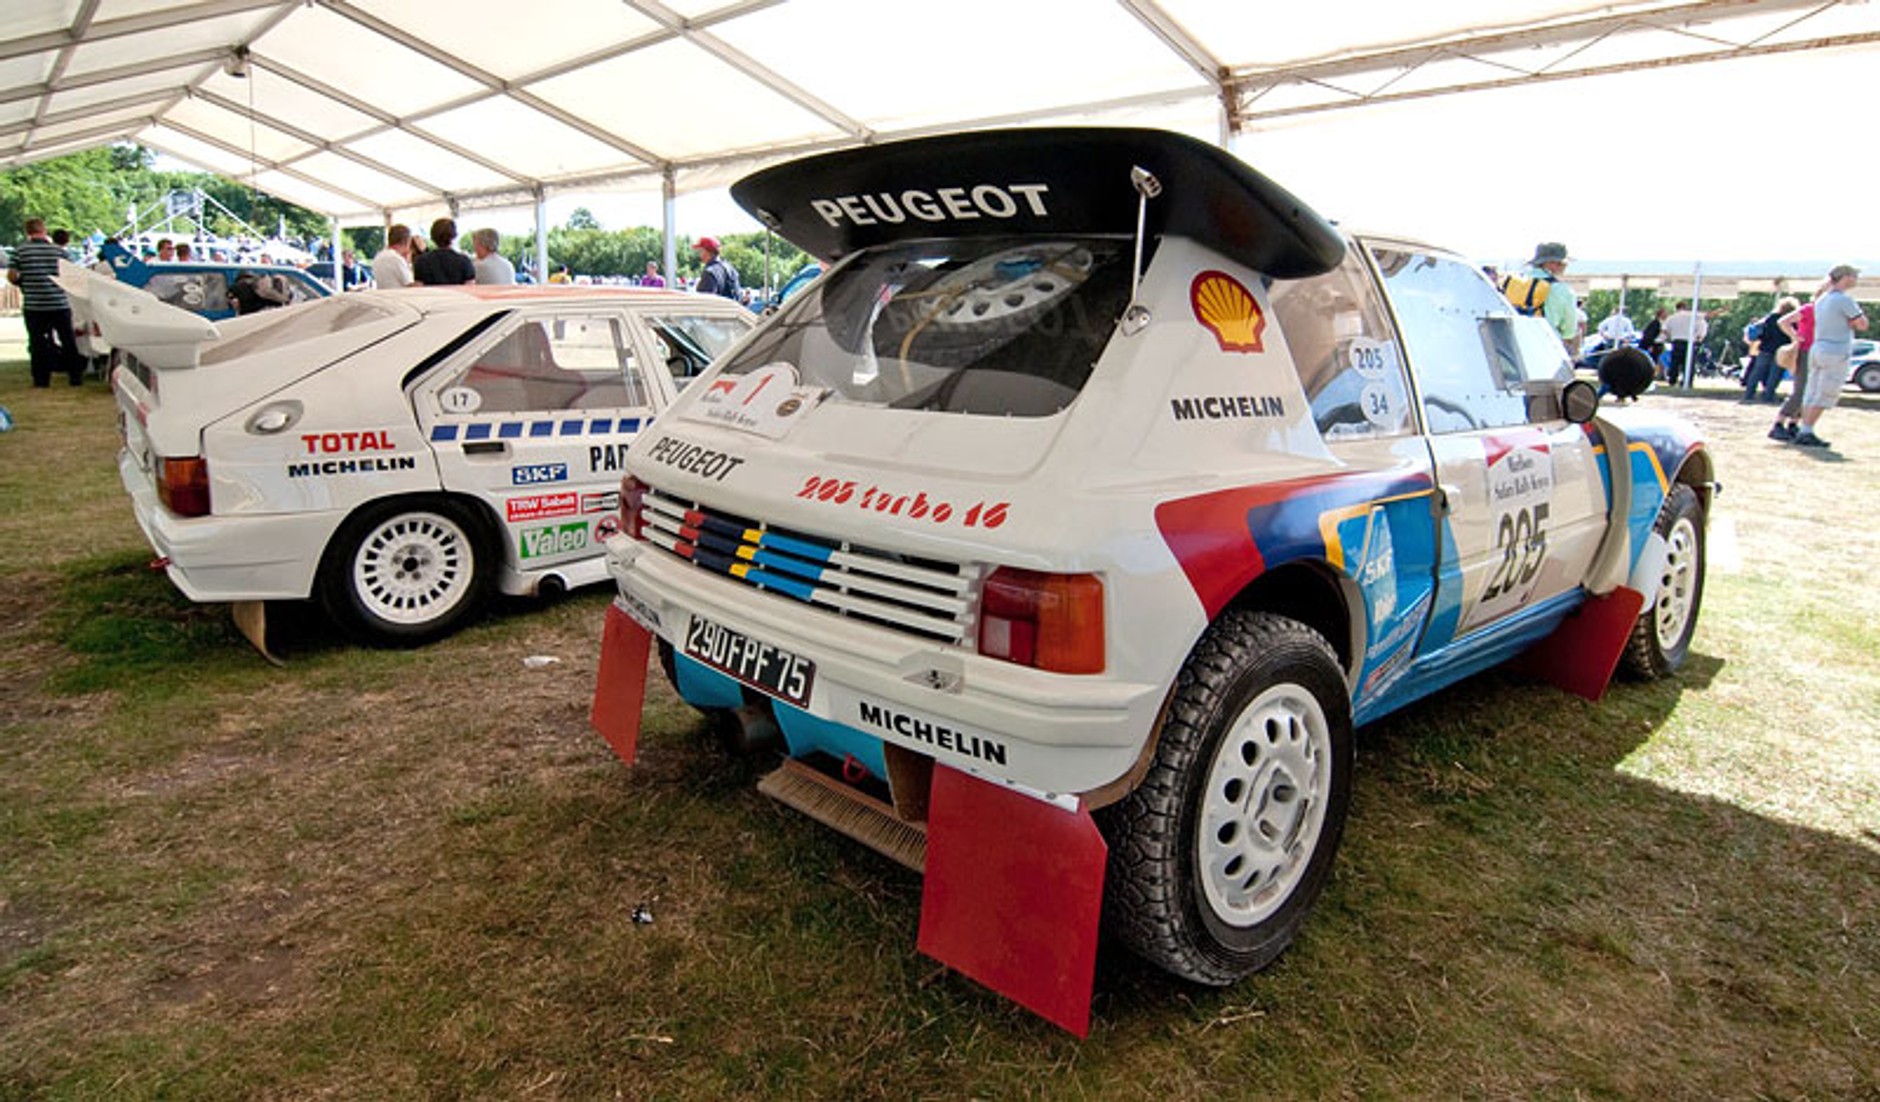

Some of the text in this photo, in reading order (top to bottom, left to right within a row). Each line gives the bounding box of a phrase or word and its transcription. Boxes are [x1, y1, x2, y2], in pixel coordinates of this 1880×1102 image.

[811, 183, 1049, 228] PEUGEOT
[1354, 347, 1383, 370] 205
[453, 392, 468, 407] 17
[743, 373, 774, 406] 1
[1171, 396, 1285, 421] MICHELIN
[1370, 392, 1388, 416] 34
[301, 431, 396, 454] TOTAL
[288, 456, 415, 478] MICHELIN
[647, 436, 745, 482] PEUGEOT
[516, 465, 563, 483] SKF
[509, 498, 540, 513] TRW
[796, 475, 1011, 529] 205 turbo 16
[523, 526, 587, 557] Valeo
[1481, 502, 1549, 603] 205
[777, 648, 810, 700] 75
[860, 701, 1007, 766] MICHELIN
